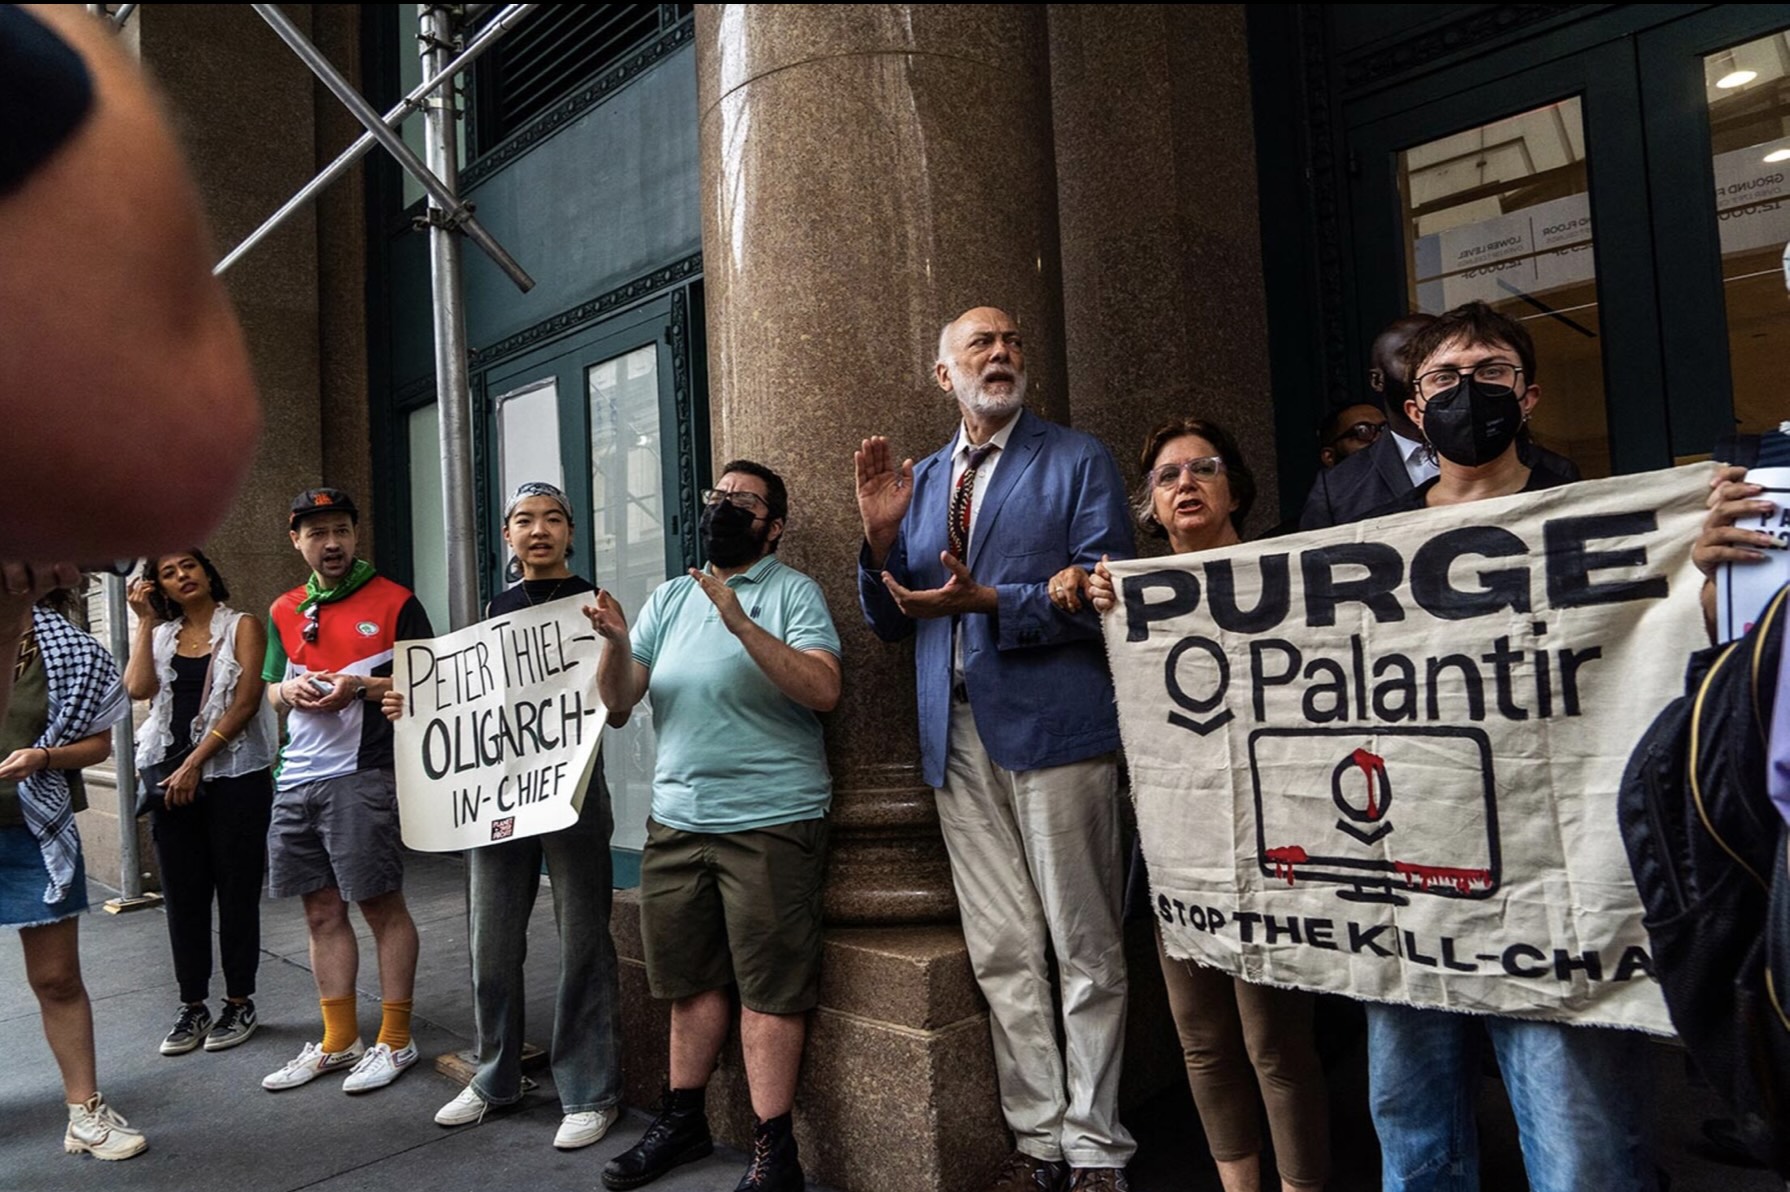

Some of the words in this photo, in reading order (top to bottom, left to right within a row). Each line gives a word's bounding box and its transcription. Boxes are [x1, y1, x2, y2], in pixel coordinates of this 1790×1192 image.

[1123, 510, 1669, 642] PURGE
[407, 641, 494, 718] PETER
[1249, 621, 1602, 724] Palantir
[1157, 893, 1227, 934] STOP
[1233, 911, 1339, 951] THE
